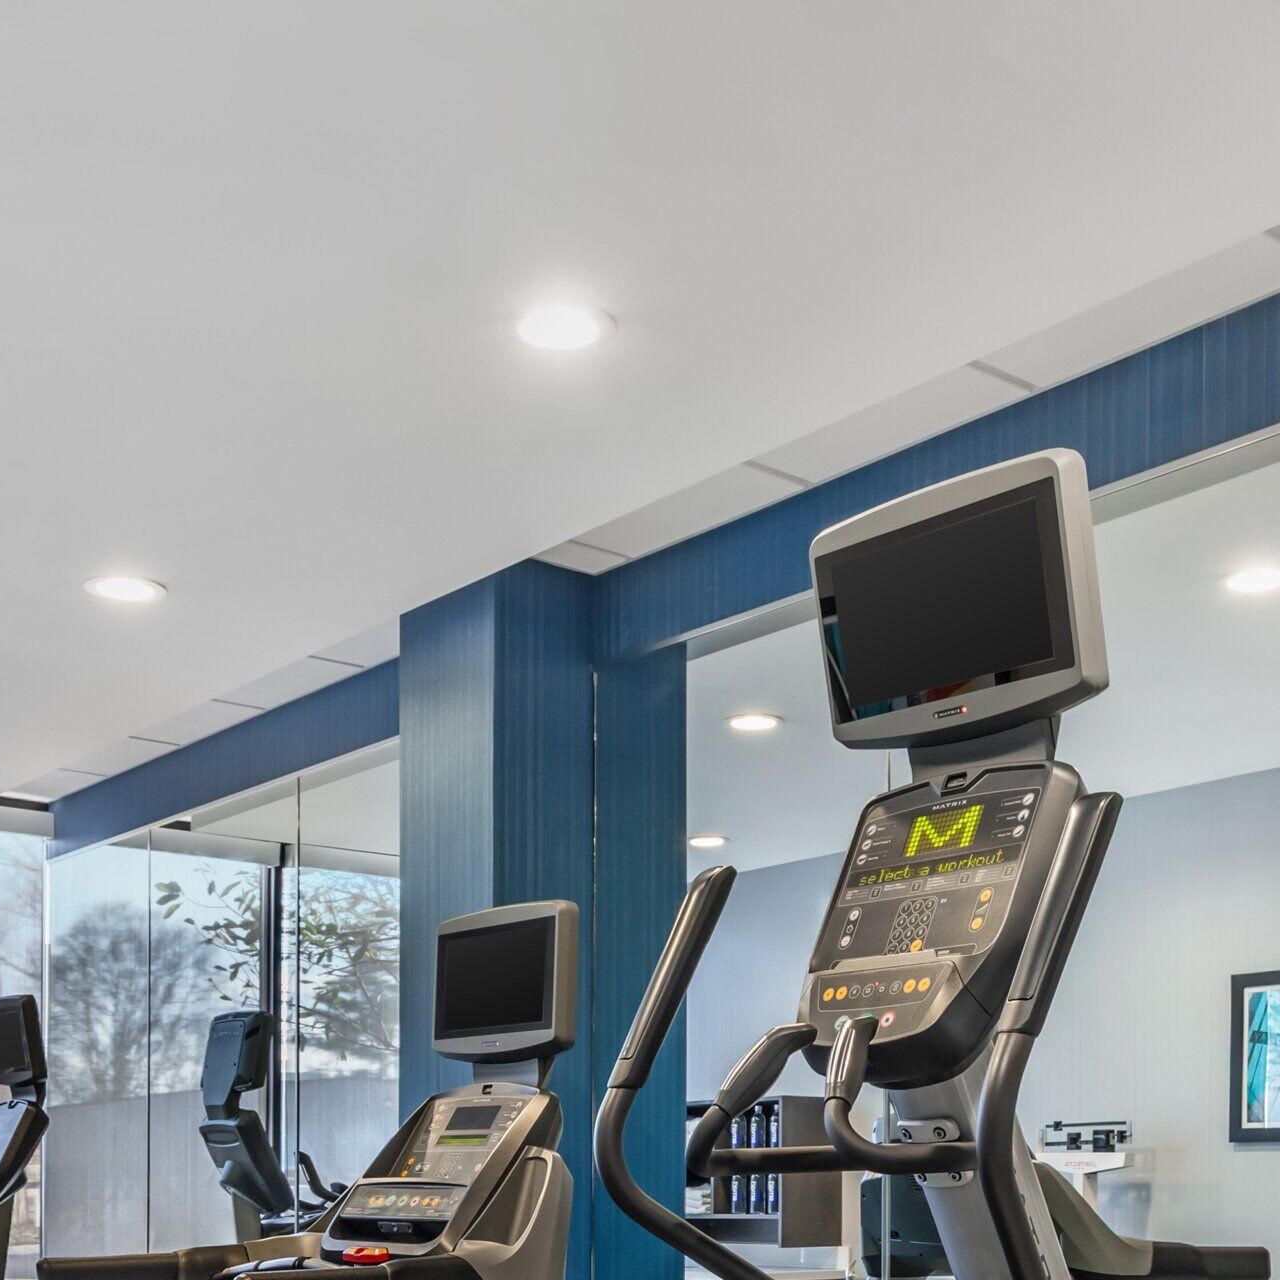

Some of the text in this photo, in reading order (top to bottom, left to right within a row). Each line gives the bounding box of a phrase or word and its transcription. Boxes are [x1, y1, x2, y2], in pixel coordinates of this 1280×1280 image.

[932, 800, 968, 811] MATRIX
[858, 864, 911, 886] select
[920, 866, 930, 876] a
[937, 848, 1004, 873] workout
